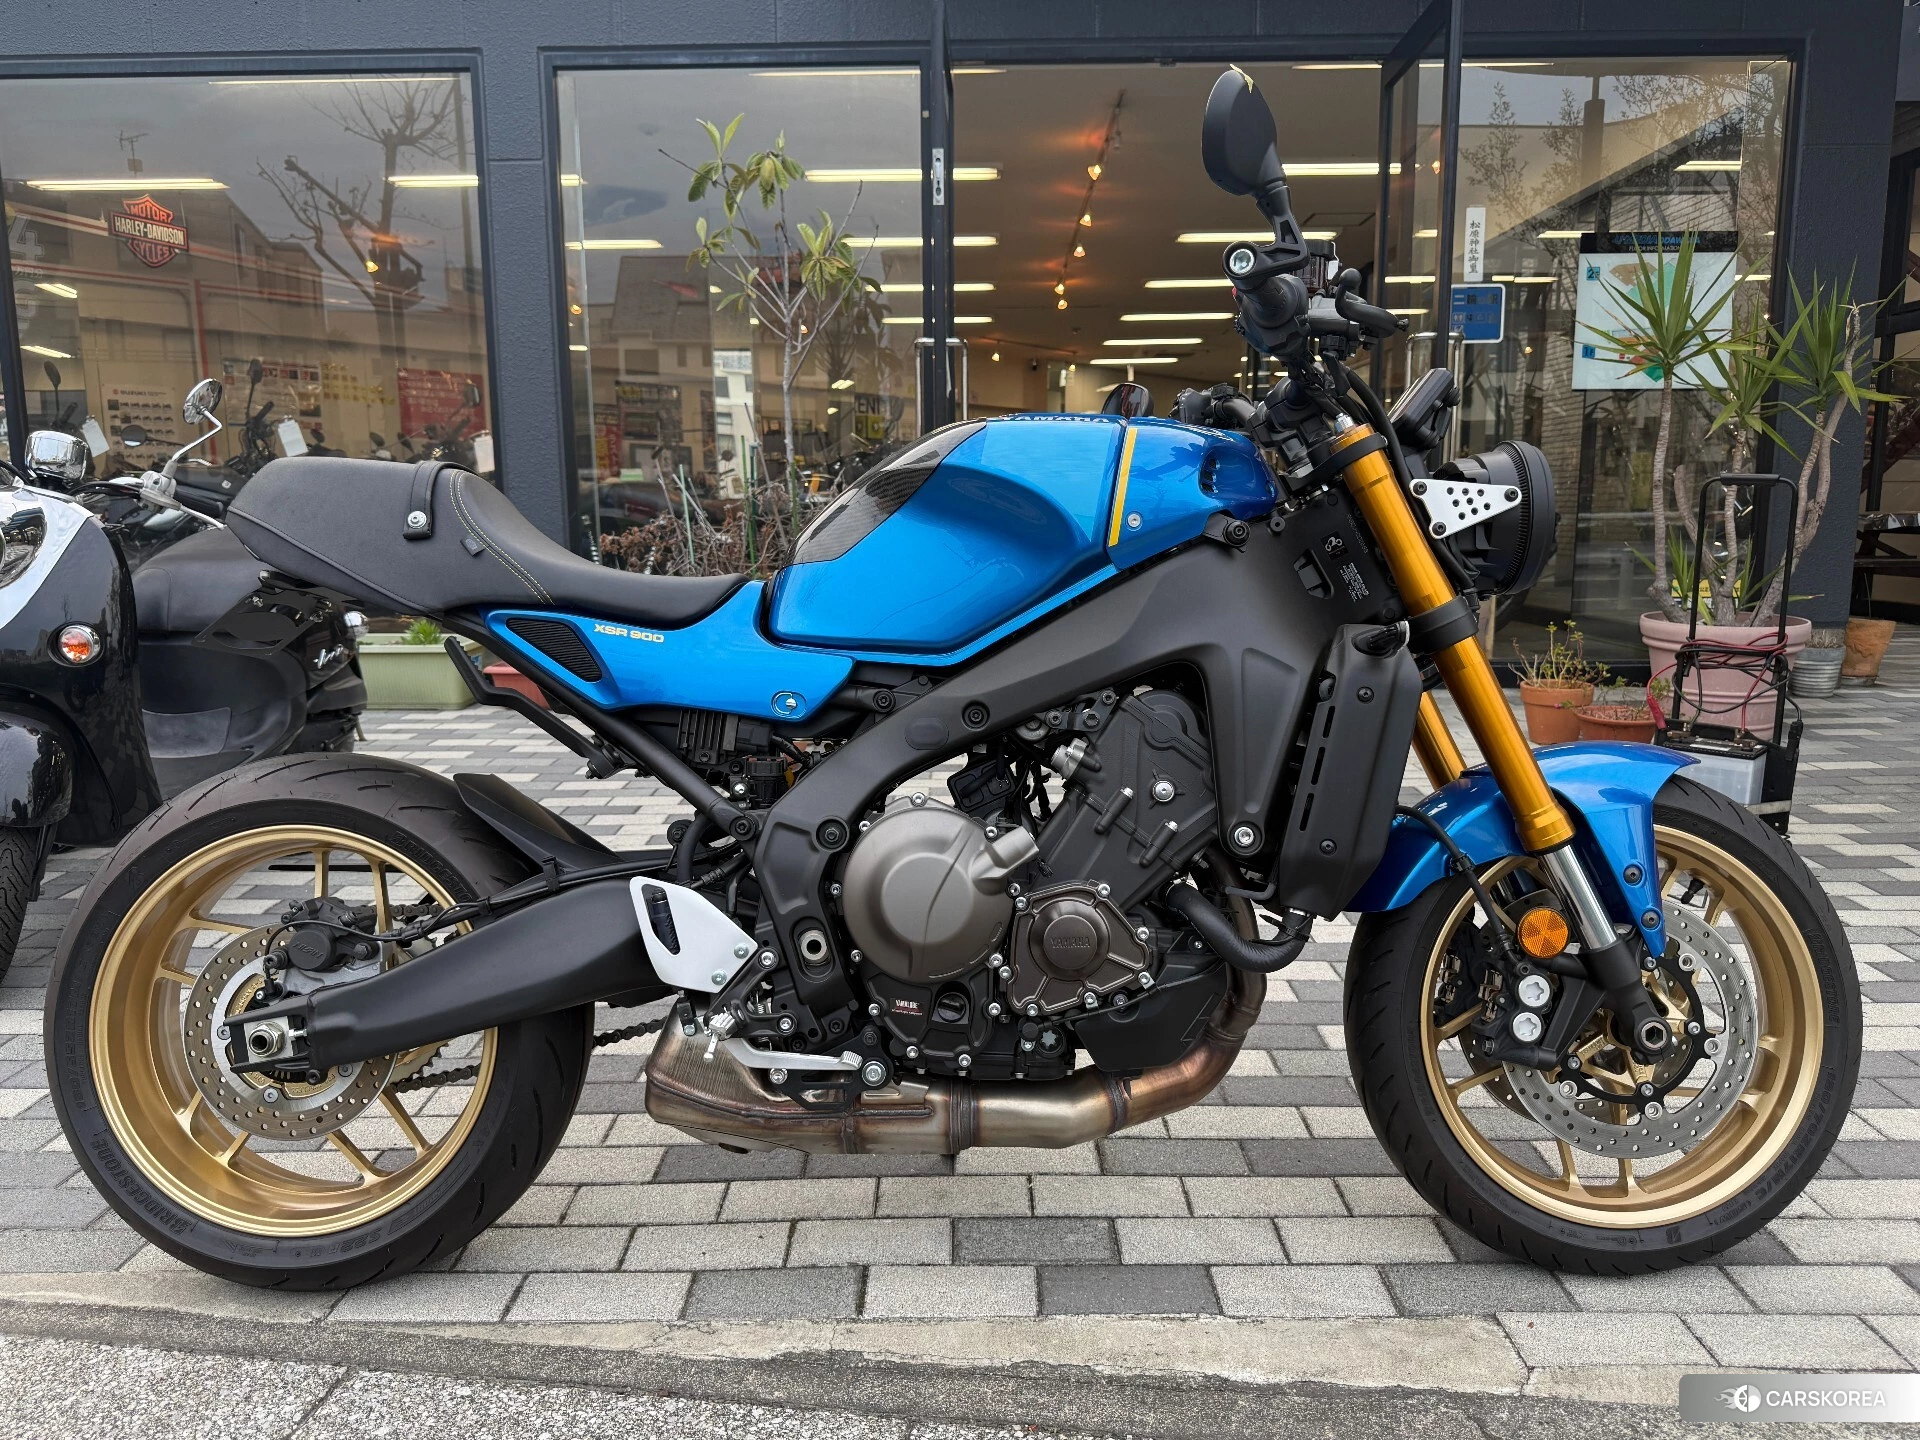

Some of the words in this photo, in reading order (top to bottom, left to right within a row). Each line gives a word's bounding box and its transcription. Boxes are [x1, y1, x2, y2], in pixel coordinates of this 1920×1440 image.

[130, 202, 168, 223] MOTOR
[114, 216, 185, 246] HARLEY-DAVIDSON
[133, 240, 170, 263] CYCLES
[594, 623, 628, 637] XSR
[630, 630, 665, 643] 900
[90, 1138, 193, 1236] BRIDGESTONE
